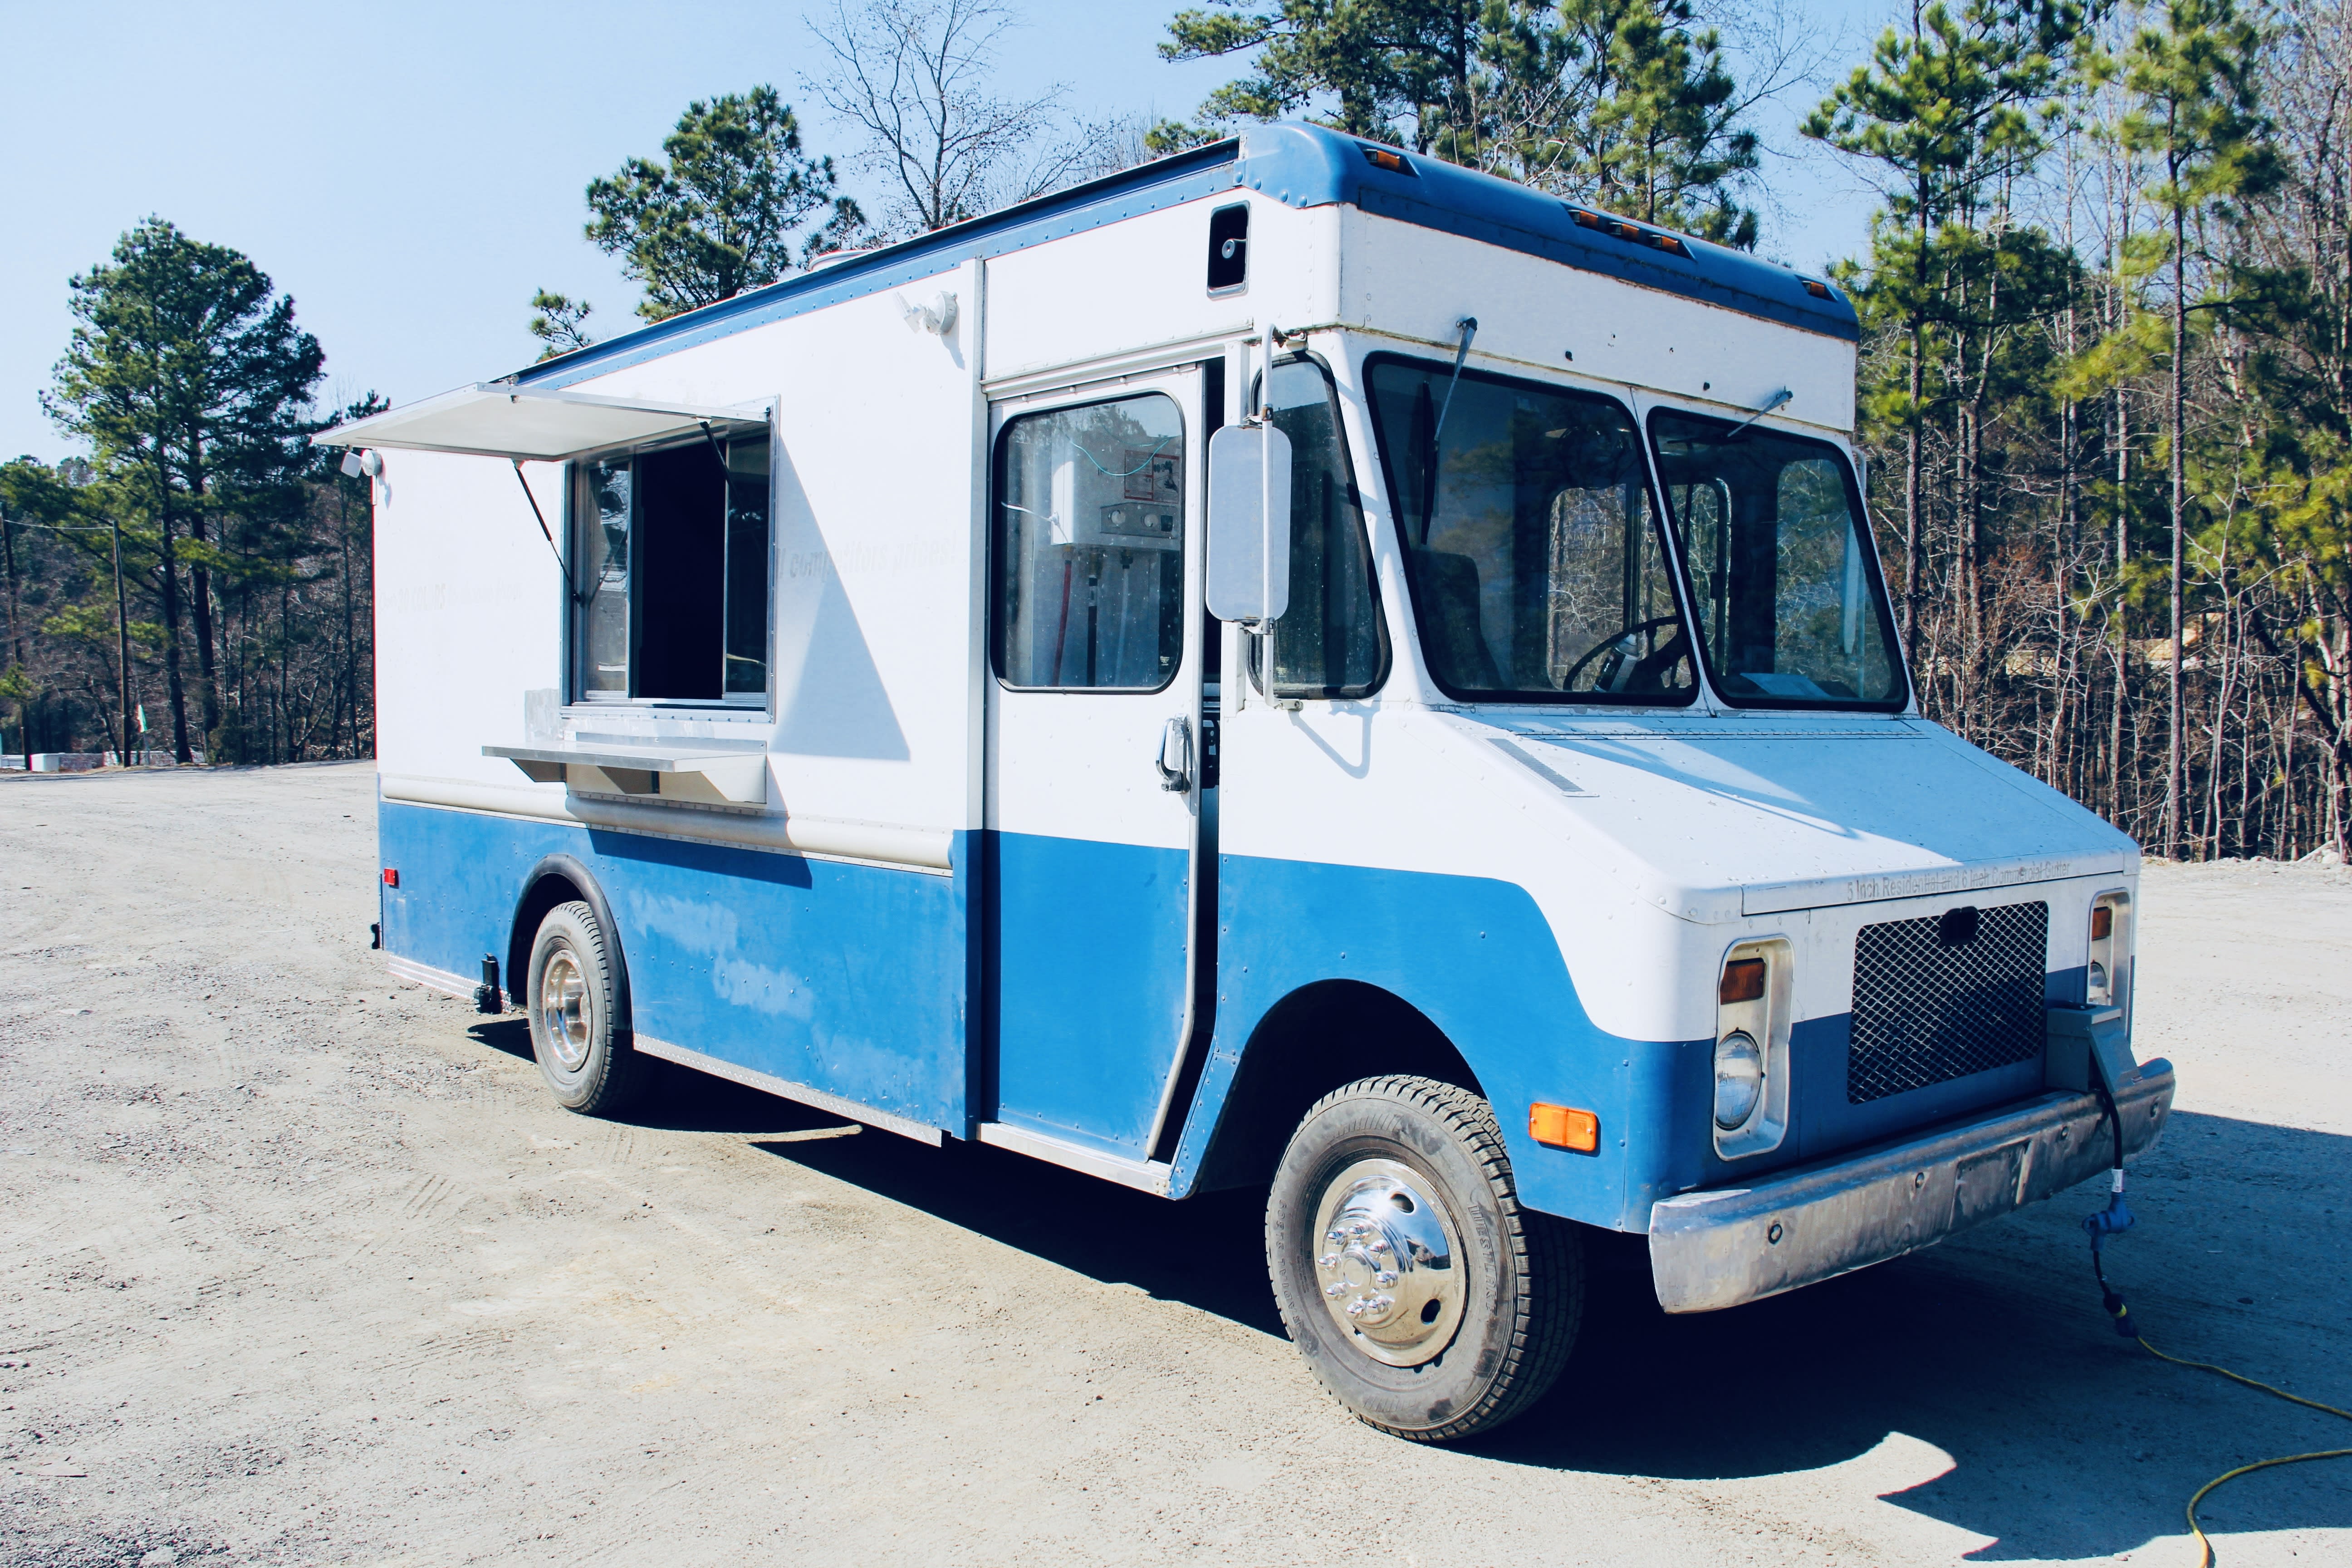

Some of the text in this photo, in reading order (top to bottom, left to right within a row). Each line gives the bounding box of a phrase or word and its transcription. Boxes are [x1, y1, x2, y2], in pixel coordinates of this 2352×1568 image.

[1847, 861, 2070, 902] 5 Inch Residential and 6 Inch Commercial Gutter
[1279, 1258, 1302, 1325] RADIAL
[1468, 1205, 1497, 1316] WESTLAKE
